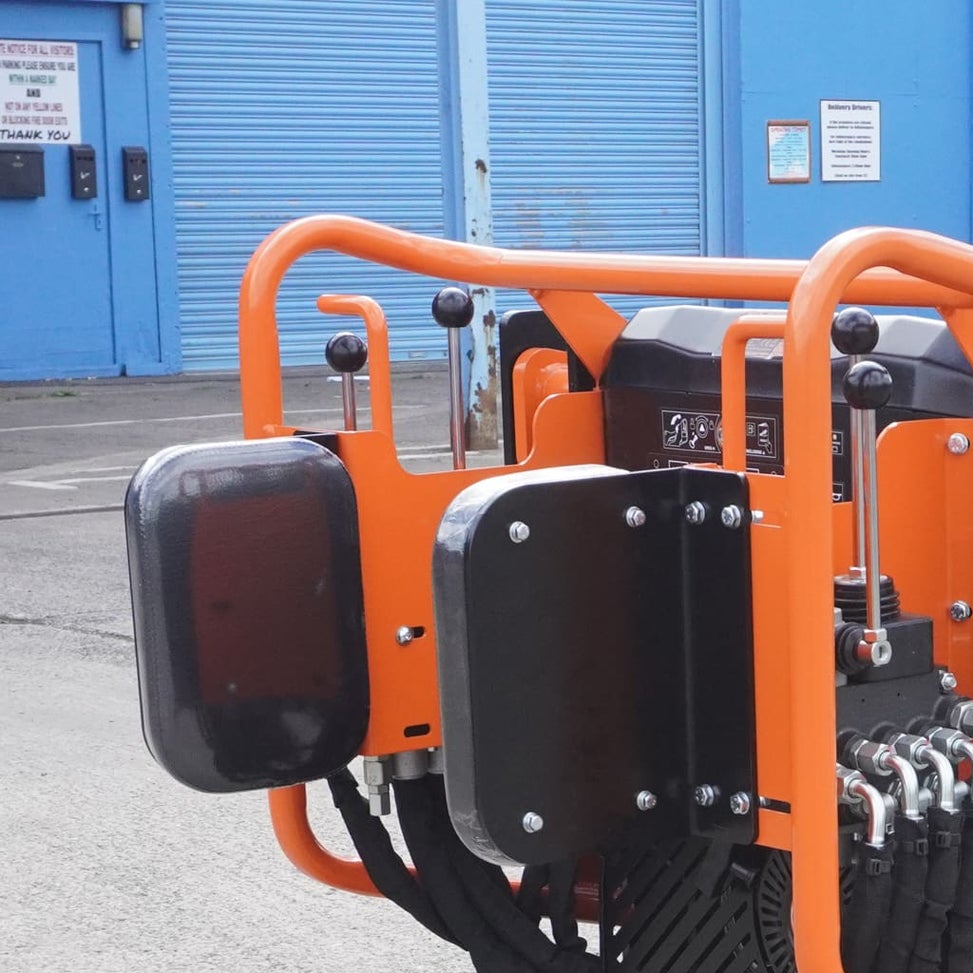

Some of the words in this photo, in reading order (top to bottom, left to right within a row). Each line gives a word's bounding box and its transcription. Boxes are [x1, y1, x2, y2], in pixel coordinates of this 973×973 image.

[7, 44, 26, 54] NOTICE
[27, 44, 37, 54] FOR
[40, 45, 49, 55] ALL
[26, 88, 41, 98] AND
[0, 129, 43, 140] THANK
[47, 130, 71, 140] YOU
